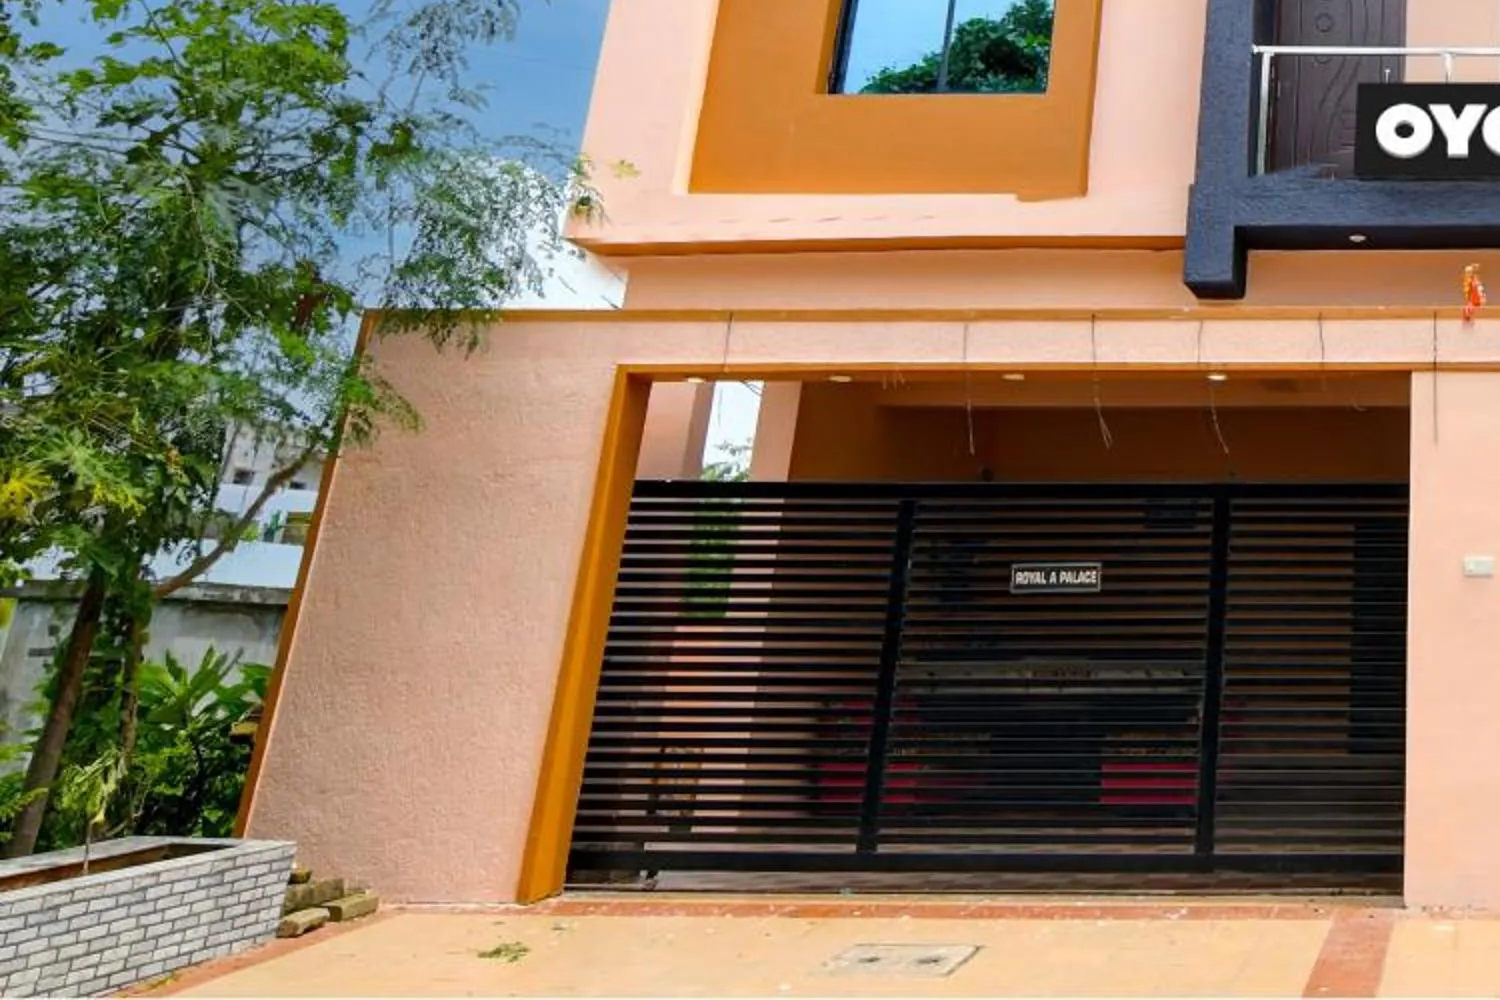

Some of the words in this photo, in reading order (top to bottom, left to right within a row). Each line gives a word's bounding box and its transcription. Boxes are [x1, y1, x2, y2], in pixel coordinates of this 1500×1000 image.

[1015, 571, 1047, 585] ROYAL
[1049, 571, 1057, 585] A
[1059, 570, 1097, 584] PALACE
